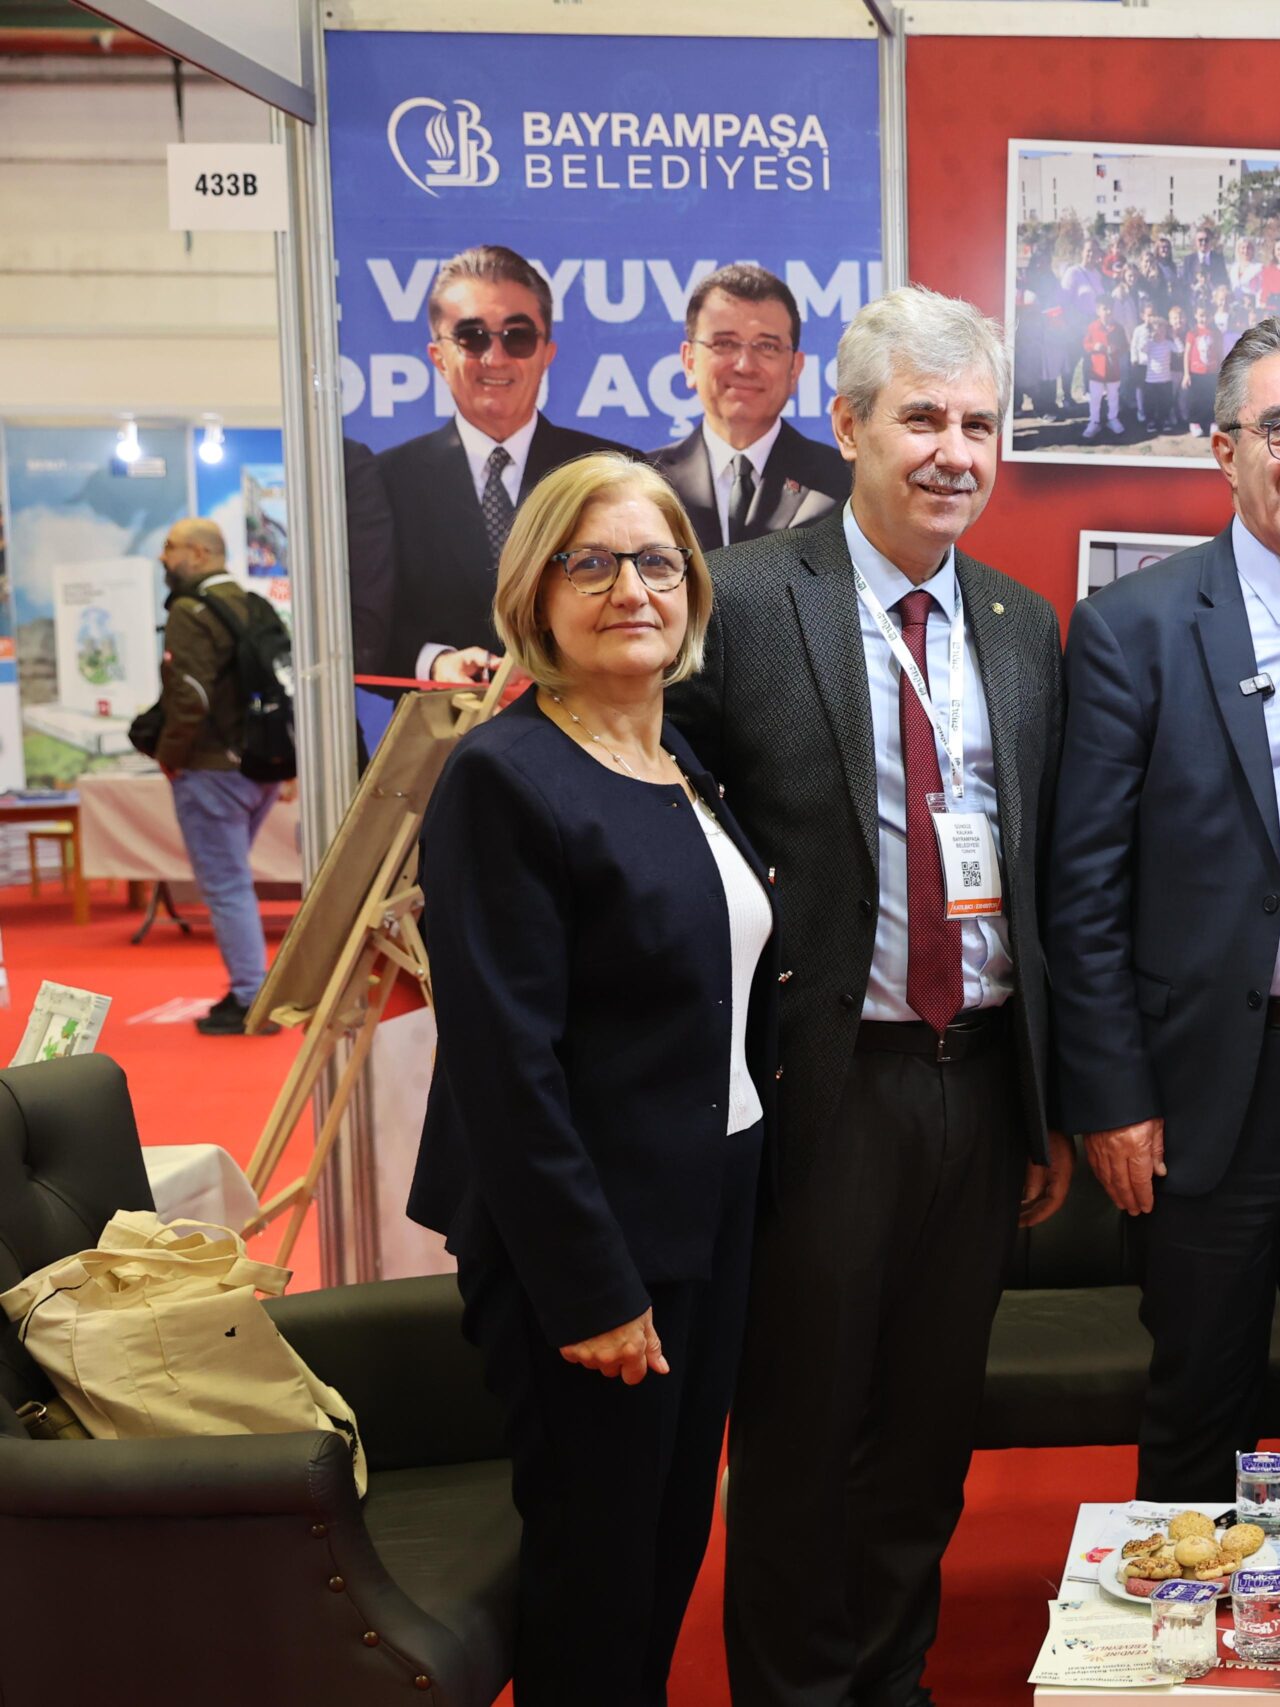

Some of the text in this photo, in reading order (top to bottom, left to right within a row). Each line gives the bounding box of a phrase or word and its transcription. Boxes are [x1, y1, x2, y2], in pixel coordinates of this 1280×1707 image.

[522, 112, 829, 158] BAYRAMPAŞA
[195, 173, 258, 197] 433B
[525, 147, 830, 191] BELEDİYESİ
